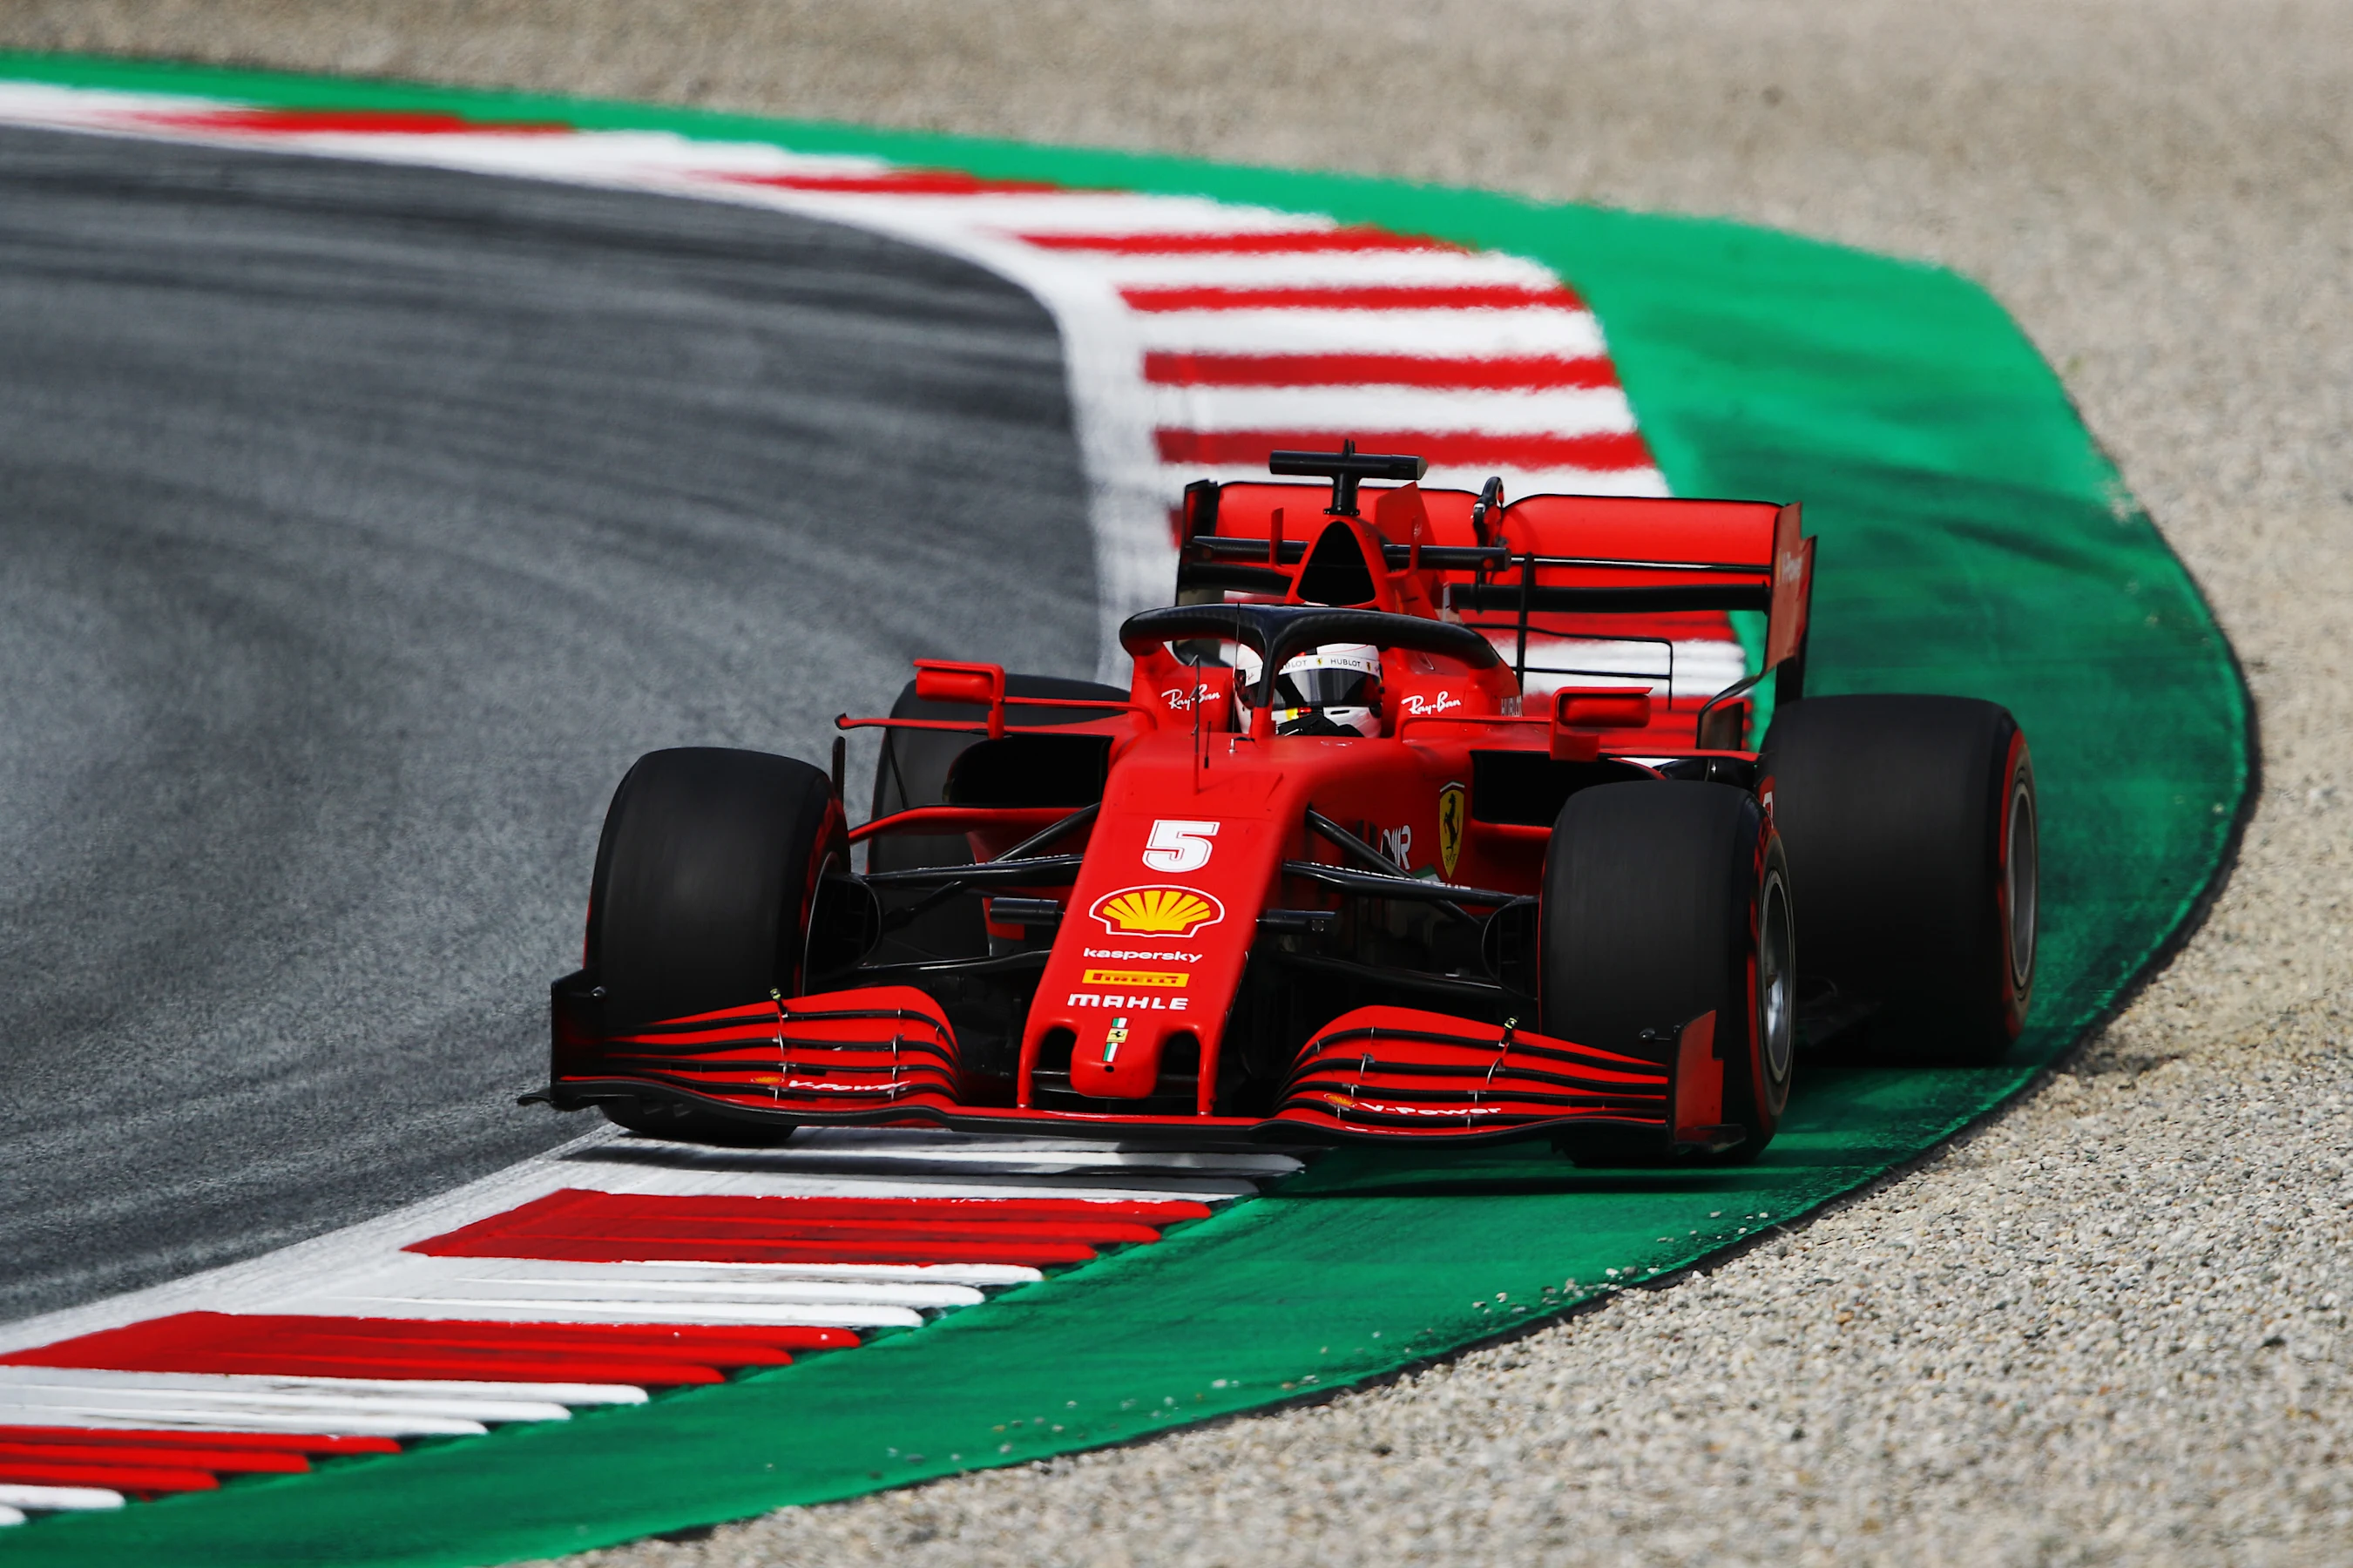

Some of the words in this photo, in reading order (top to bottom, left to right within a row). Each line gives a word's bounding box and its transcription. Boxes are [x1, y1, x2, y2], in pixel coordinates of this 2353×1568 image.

[1285, 659, 1308, 669] BLOT
[1330, 659, 1361, 668] HUBLOT
[1142, 819, 1220, 872] 5
[1083, 948, 1202, 963] kaspersky
[1067, 993, 1189, 1010] MAHLE
[788, 1080, 910, 1091] V-Power
[1360, 1102, 1501, 1115] V-Power
